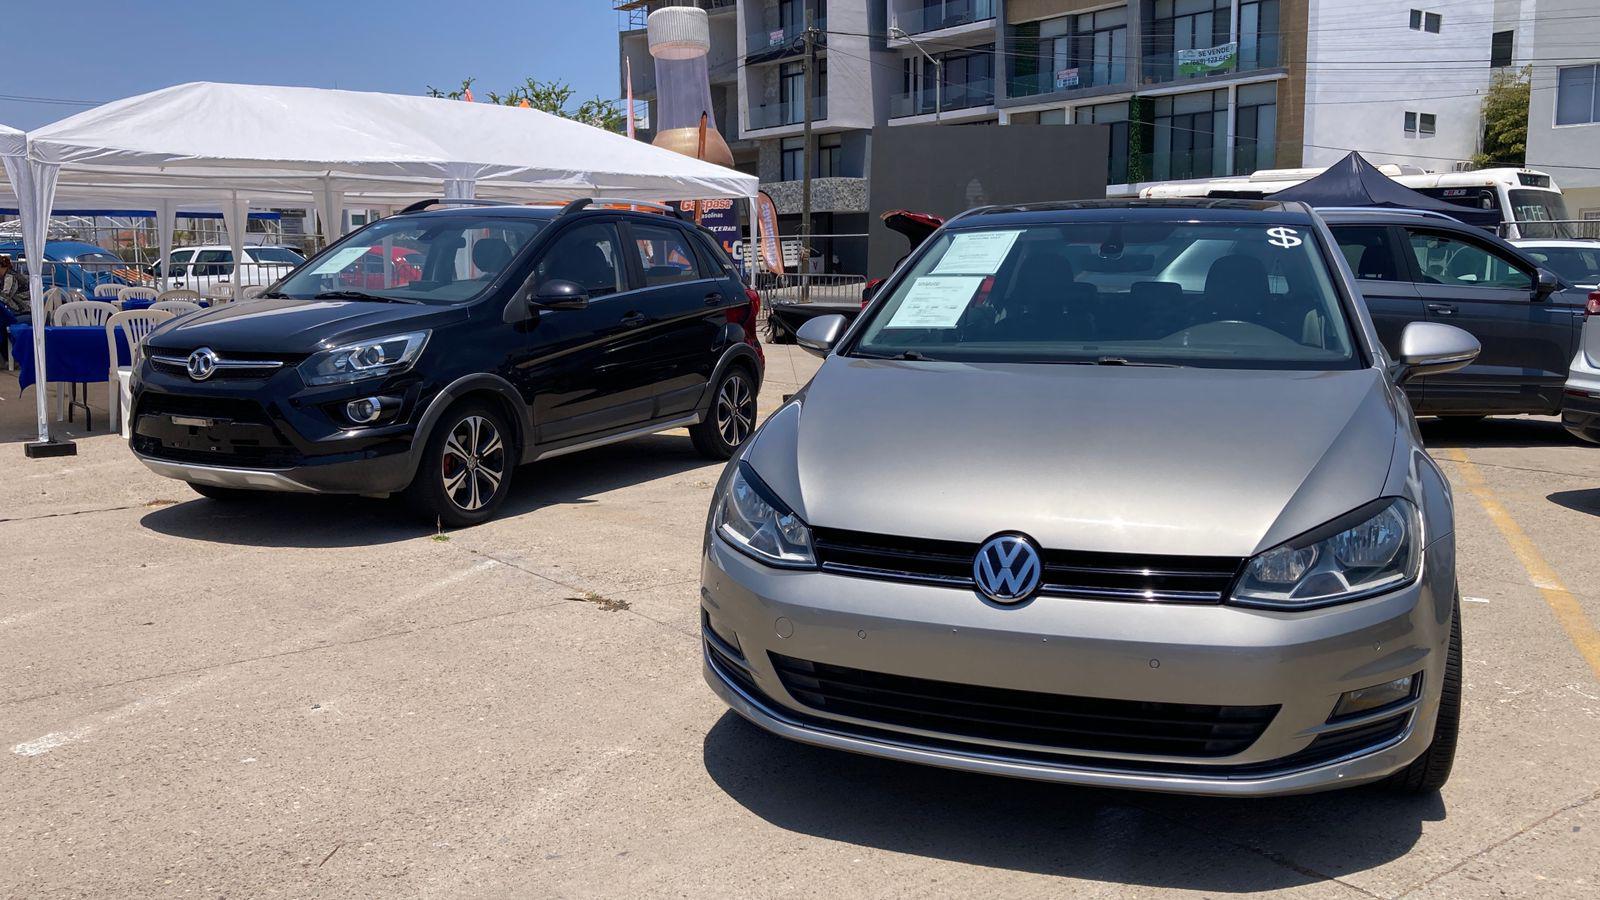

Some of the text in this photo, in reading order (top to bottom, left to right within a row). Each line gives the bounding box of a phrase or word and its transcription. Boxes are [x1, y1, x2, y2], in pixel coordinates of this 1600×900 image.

[1207, 47, 1230, 56] VENDE
[1266, 226, 1303, 249] $
[976, 537, 1038, 599] VW
